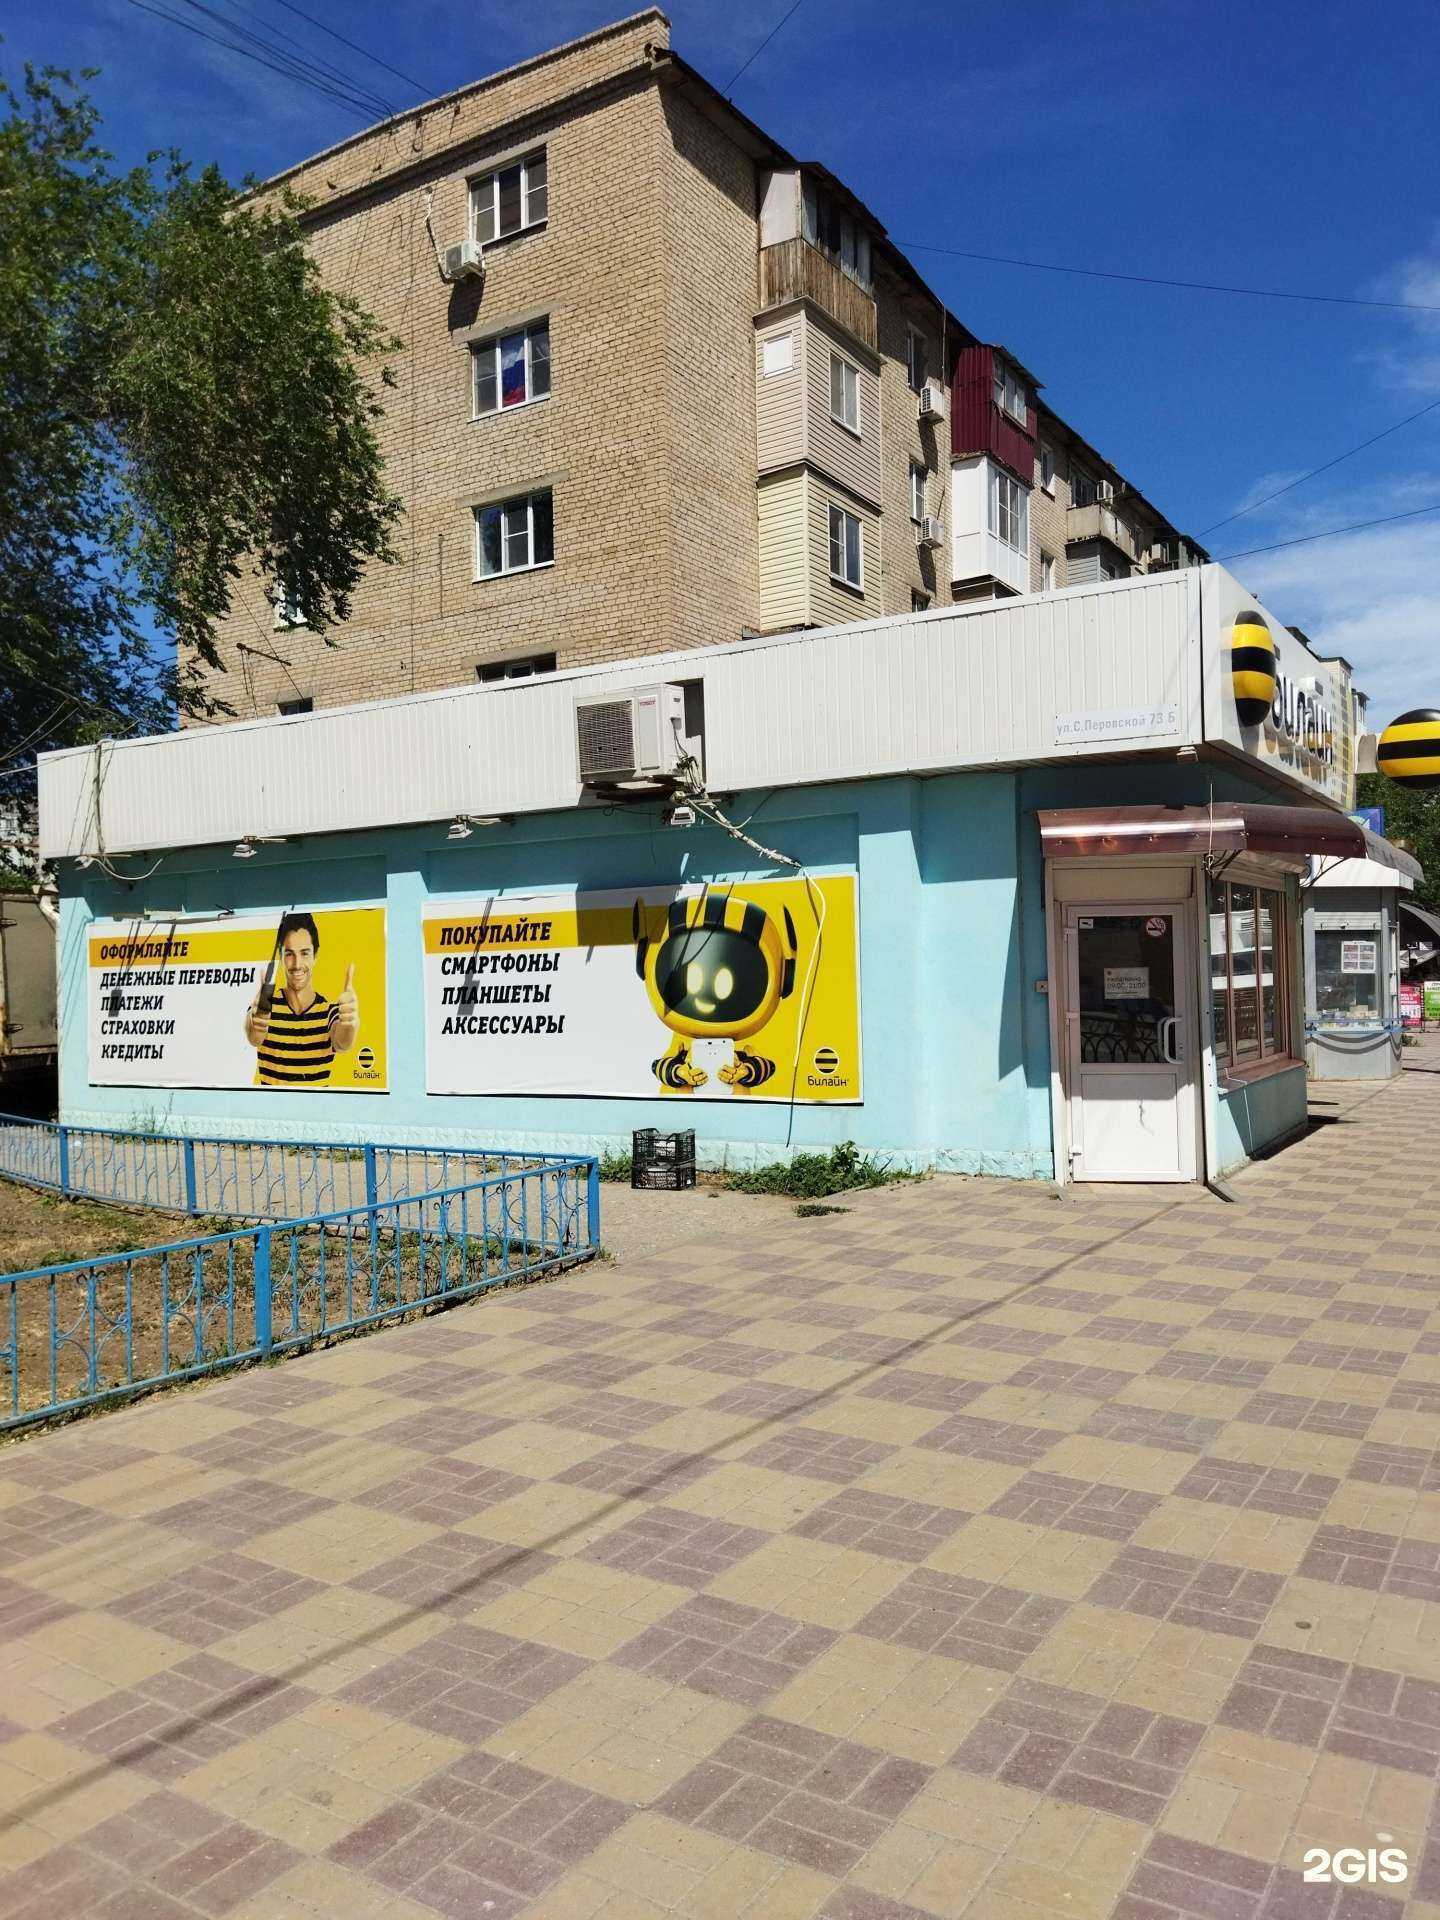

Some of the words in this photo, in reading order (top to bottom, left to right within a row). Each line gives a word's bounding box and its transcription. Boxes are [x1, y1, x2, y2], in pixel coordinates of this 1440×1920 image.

[1150, 712, 1164, 725] 73
[440, 917, 552, 945] ПОКУПАЙТЕ
[100, 941, 189, 960] ОФОРМЛЯЙТЕ
[441, 952, 561, 975] СМАРТФОНЫ
[100, 970, 176, 990] ДЕНЕЖНЫЕ
[178, 967, 256, 987] ПЕРЕВОДЫ
[100, 995, 164, 1011] ПЛАТЕЖИ
[442, 984, 552, 1005] ПЛАНШЕТЫ
[101, 1020, 175, 1035] СТРАХОВКИ
[441, 1014, 565, 1035] АКСЕССУАРЫ
[101, 1044, 164, 1062] КРЕДИТЫ
[807, 1075, 847, 1087] Билайн
